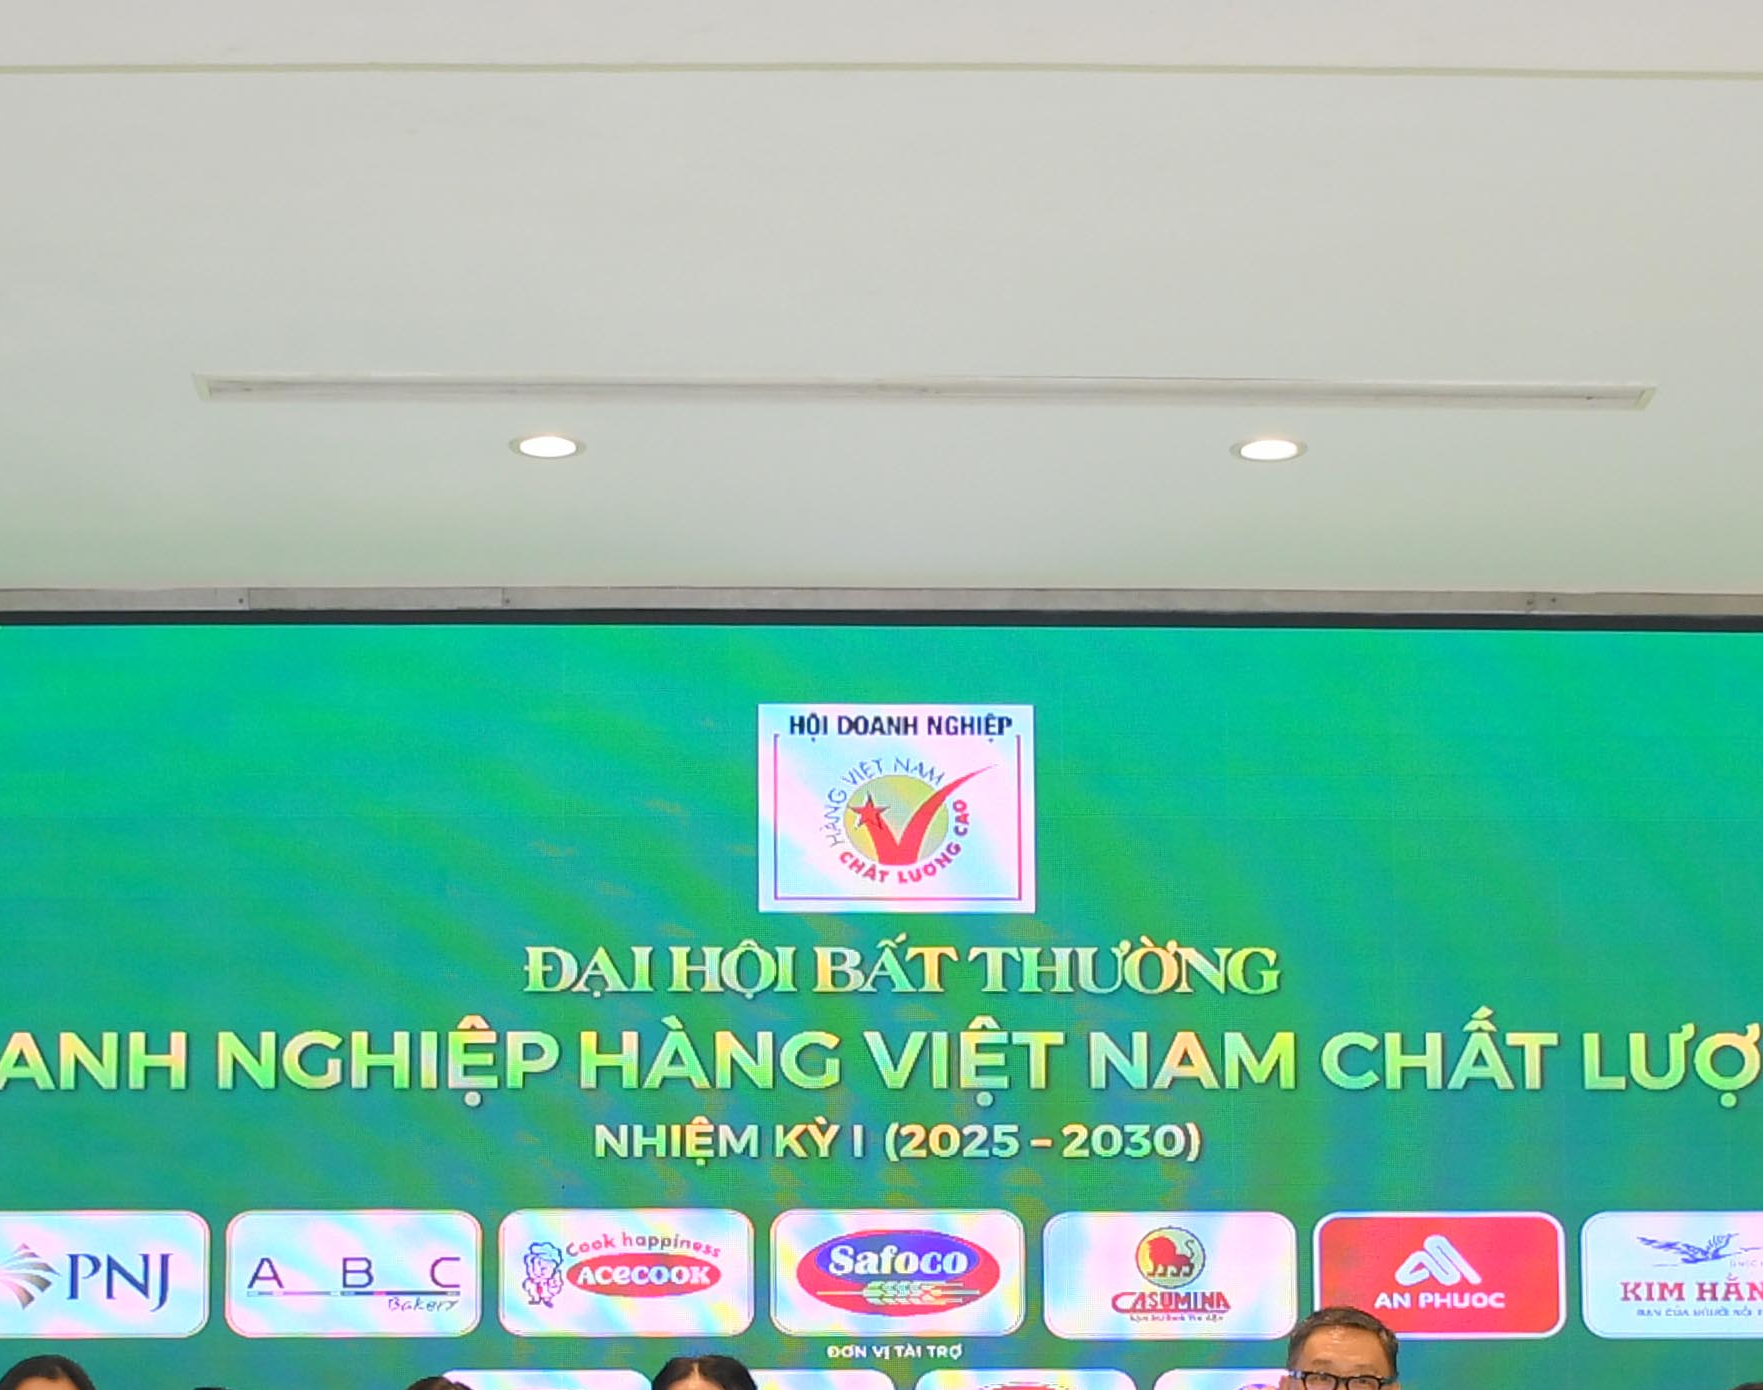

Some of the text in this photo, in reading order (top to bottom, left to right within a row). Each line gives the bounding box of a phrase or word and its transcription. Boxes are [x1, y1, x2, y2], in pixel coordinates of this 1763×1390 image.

[789, 713, 1013, 743] HỘI DOANH NGHIỆP
[893, 758, 946, 786] NAM
[952, 799, 971, 837] CAO
[523, 932, 1282, 1000] ĐẠI HỘI BẤT THƯỜNG
[216, 1014, 561, 1107] NGHIỆP
[579, 1014, 842, 1090] HÀNG
[862, 1015, 1066, 1107] VIỆT
[1088, 1030, 1297, 1090] NAM
[1320, 1004, 1560, 1091] CHẤT
[593, 1114, 760, 1166] NHIỆM
[775, 1114, 841, 1158] KỲ
[852, 1124, 865, 1158] I
[885, 1121, 1021, 1162] (2025
[1061, 1121, 1201, 1162] 2030)
[565, 1231, 722, 1259] Cook happiness
[828, 1244, 969, 1277] Safoco
[65, 1252, 174, 1313] PNJ
[1620, 1281, 1685, 1302] KIM
[388, 1296, 459, 1312] Bakery
[1111, 1291, 1232, 1314] CASUMINA
[1374, 1291, 1411, 1309] AN
[827, 1342, 963, 1360] ĐƠN VỊ TÀI TRỢ
